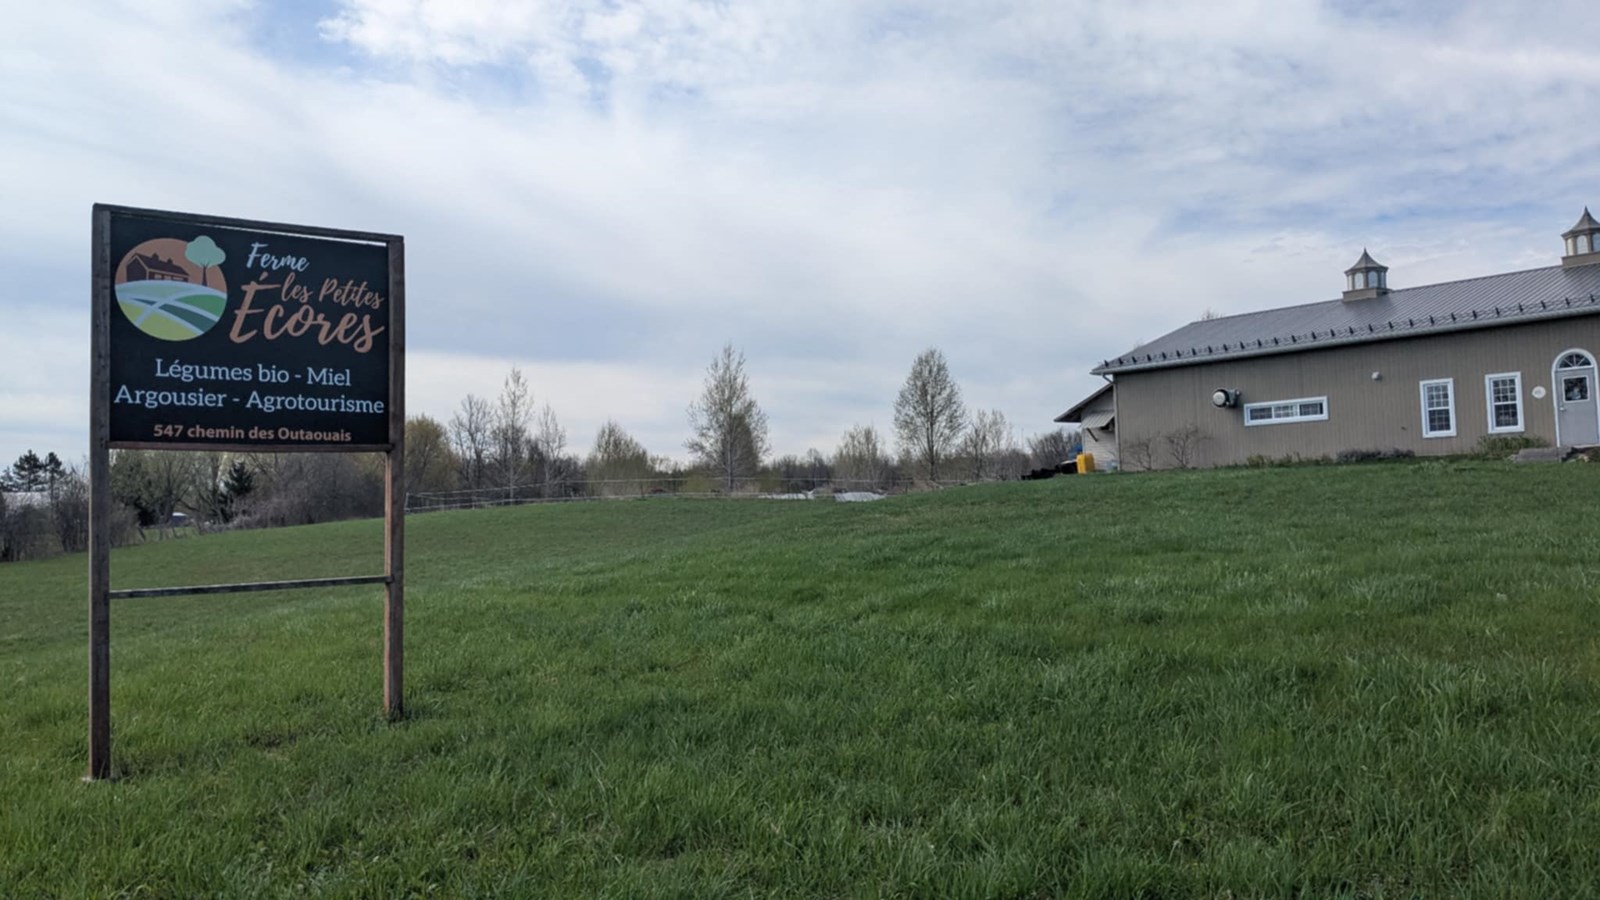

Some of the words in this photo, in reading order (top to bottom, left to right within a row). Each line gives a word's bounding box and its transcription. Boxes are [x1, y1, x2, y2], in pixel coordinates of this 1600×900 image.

[246, 242, 310, 272] Ferme
[281, 273, 313, 304] les
[318, 278, 384, 310] Petites
[230, 272, 384, 354] Écores
[155, 358, 252, 382] Légumes
[258, 364, 289, 383] bio
[307, 367, 351, 386] Miel
[114, 385, 227, 408] Argousier
[246, 391, 384, 414] Agrotourisme
[153, 424, 183, 437] 547
[187, 425, 244, 439] chemin
[248, 426, 274, 440] des
[278, 427, 351, 442] Outaouais
